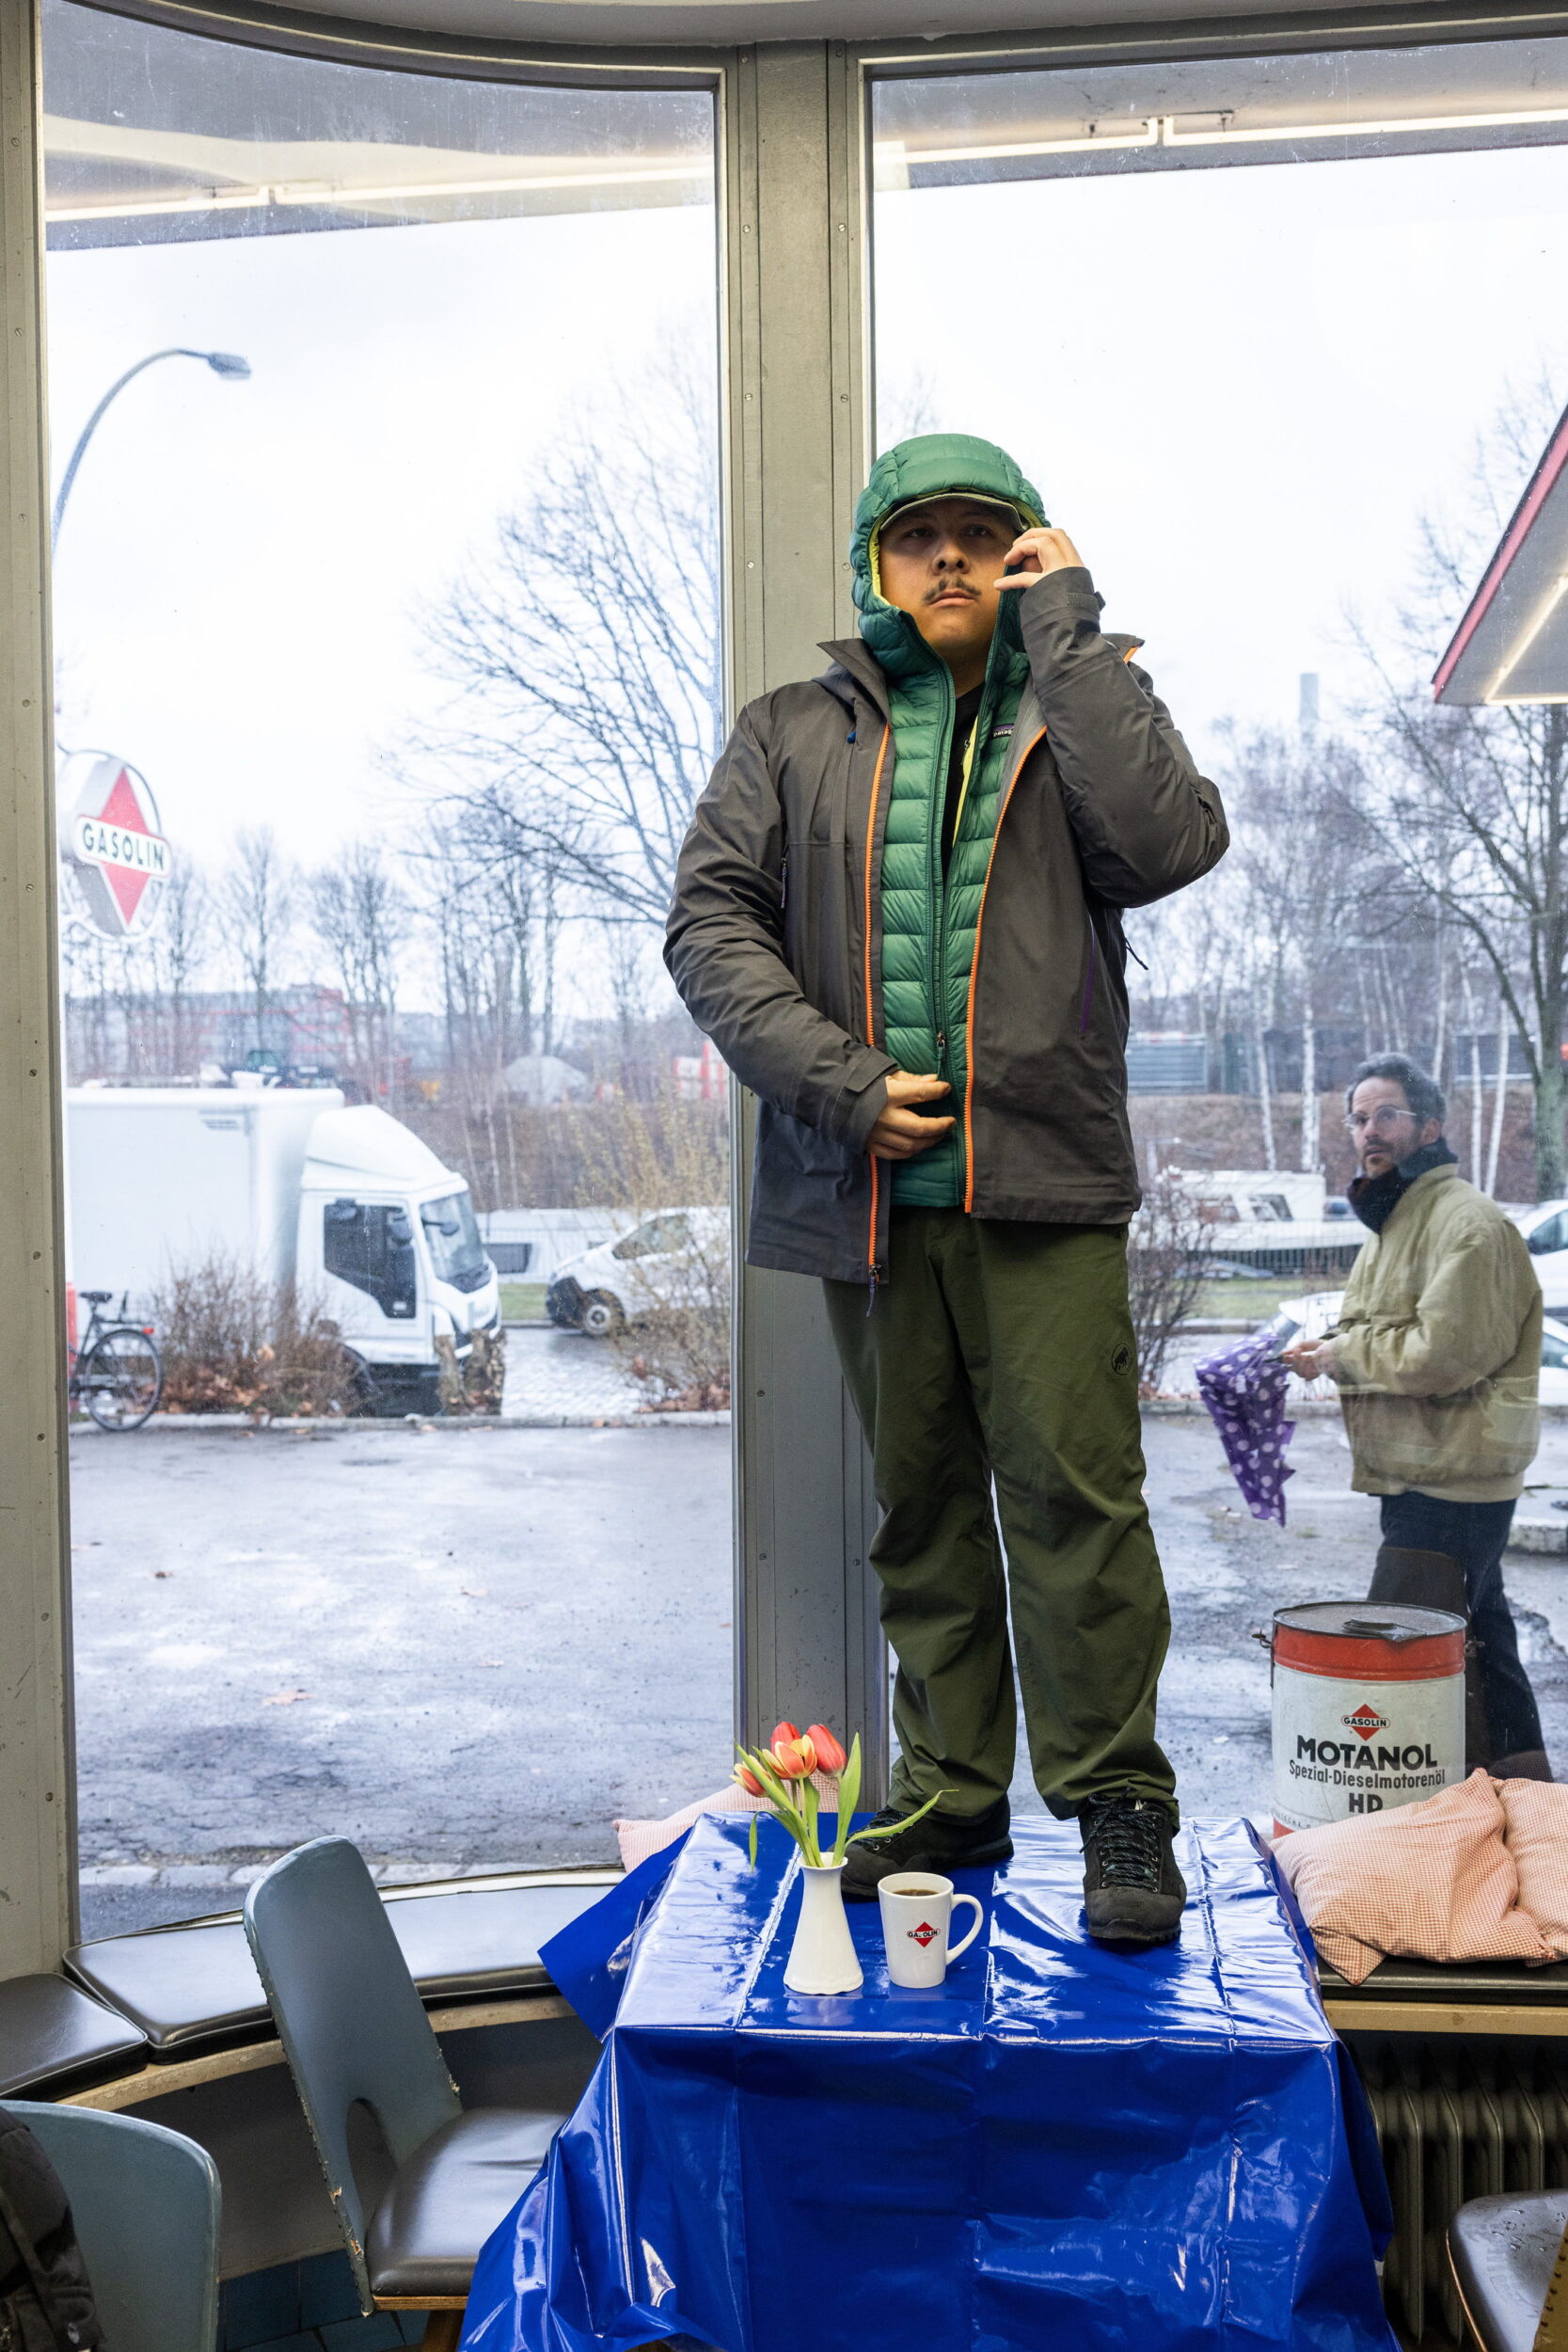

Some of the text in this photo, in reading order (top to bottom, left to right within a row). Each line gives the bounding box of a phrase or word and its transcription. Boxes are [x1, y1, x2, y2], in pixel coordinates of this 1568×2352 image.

[993, 728, 1013, 738] patag
[82, 822, 164, 871] GASOLIN
[1343, 1717, 1387, 1727] GASOLIN
[1297, 1735, 1437, 1771] MOTANOL
[1290, 1759, 1445, 1788] Spezial-Dieselmotorenöl
[1349, 1792, 1383, 1814] HD
